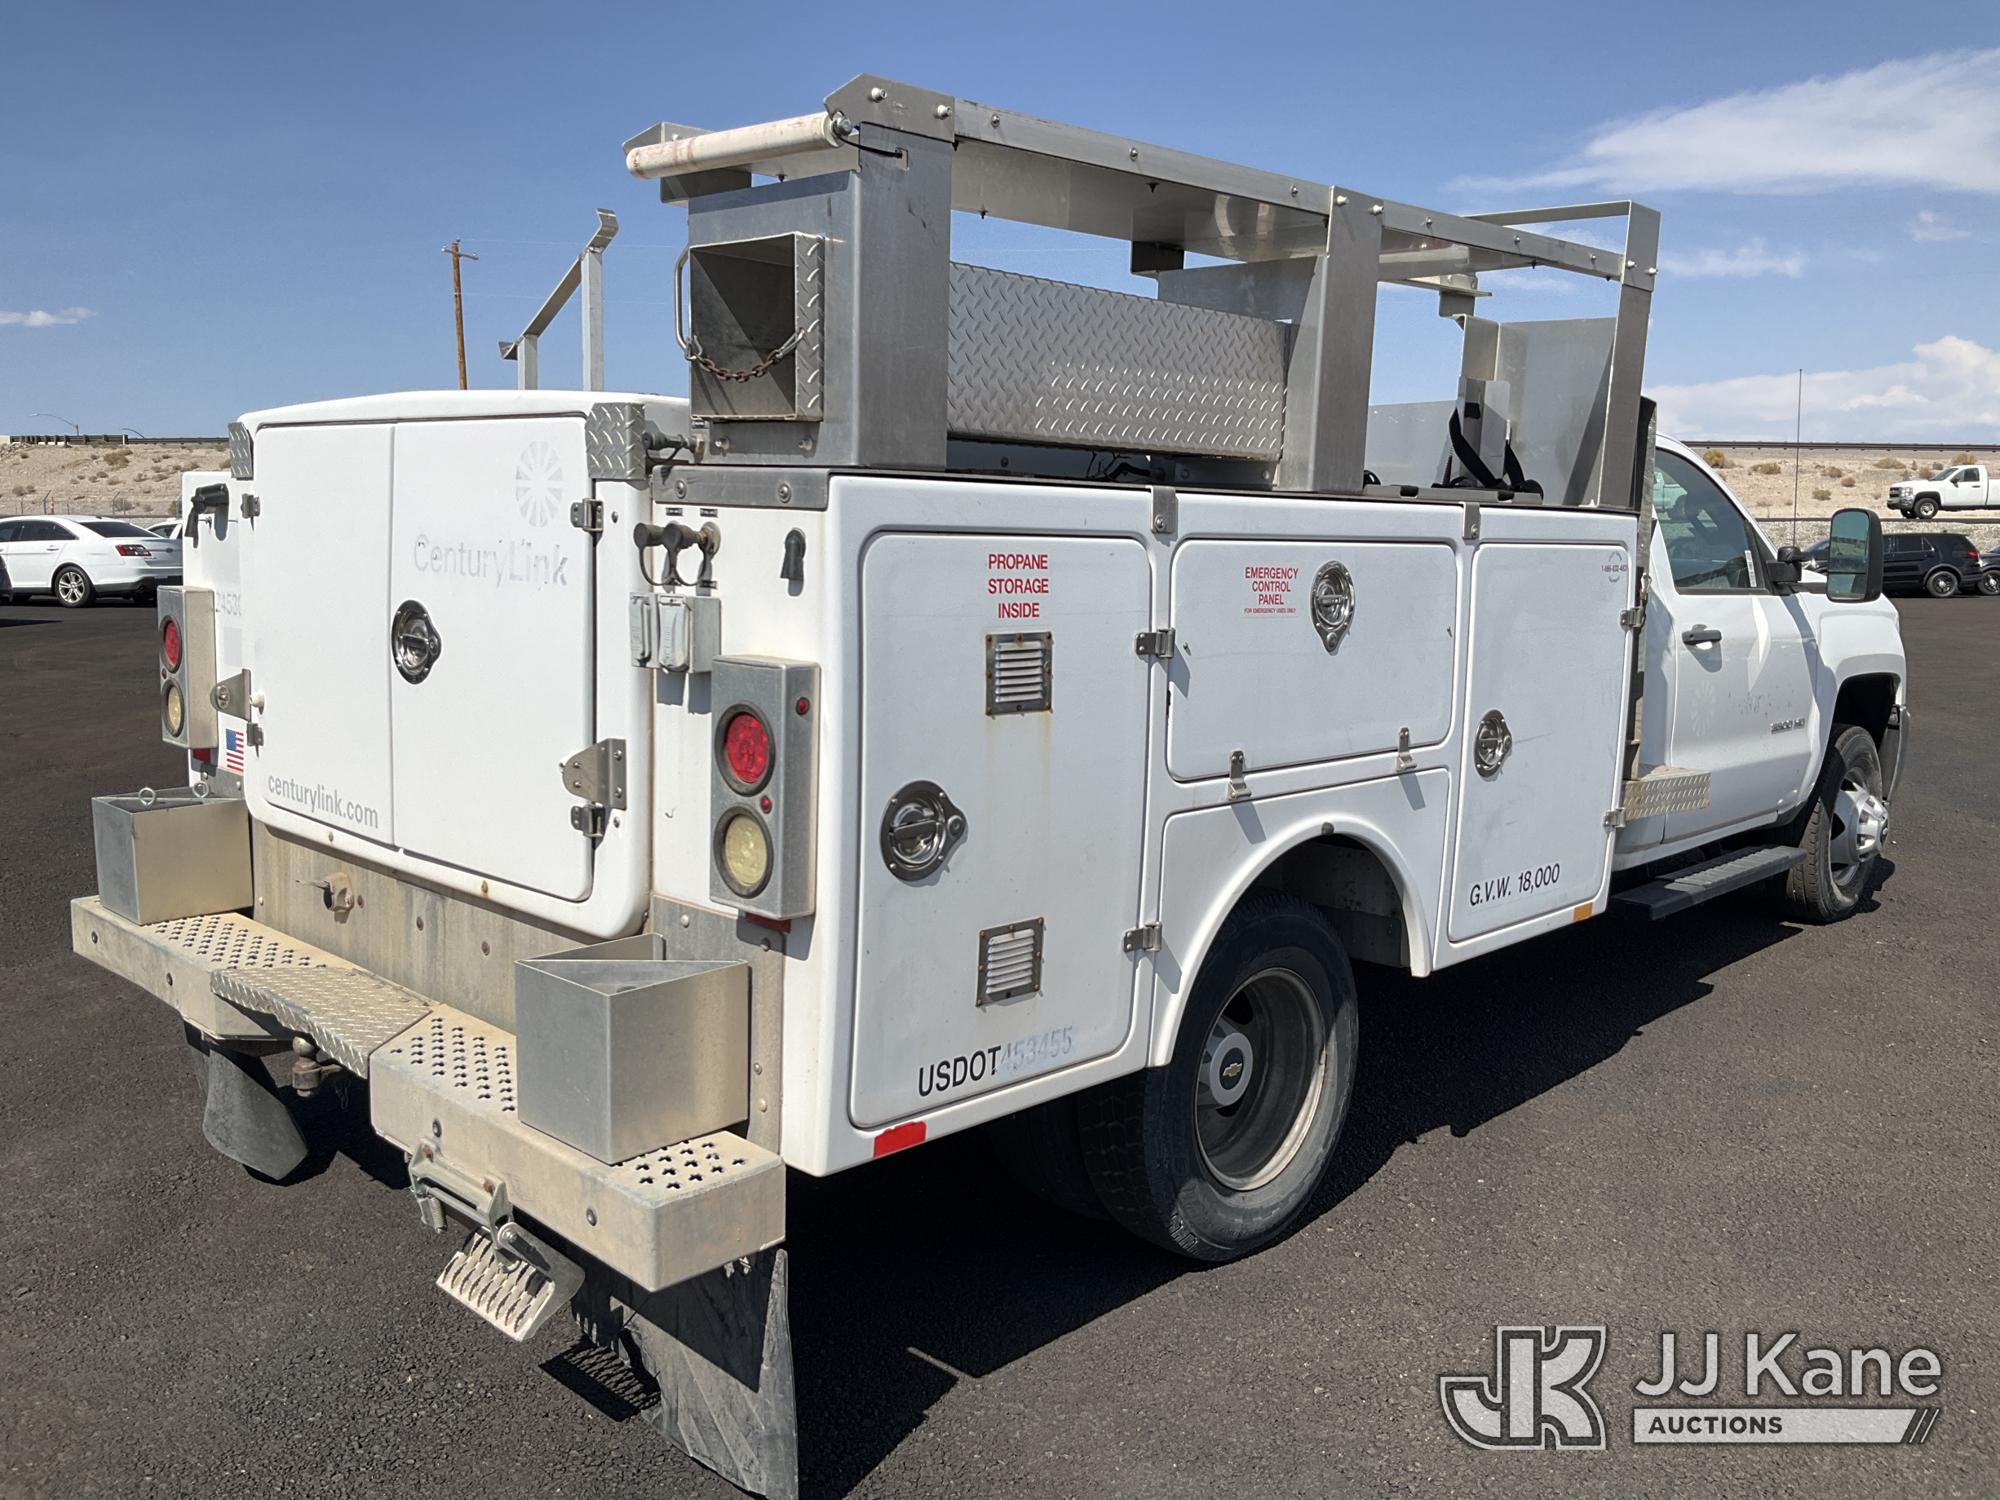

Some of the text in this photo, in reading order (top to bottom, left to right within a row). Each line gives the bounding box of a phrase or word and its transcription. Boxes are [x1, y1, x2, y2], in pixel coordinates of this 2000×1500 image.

[988, 554, 1048, 570] PROPANE
[1245, 567, 1299, 580] EMERGENCY
[988, 578, 1049, 594] STORAGE
[1252, 581, 1291, 592] CONTROL
[1259, 594, 1284, 605] PANEL
[998, 603, 1040, 618] INSIDE
[268, 776, 378, 829] centurylink.com
[1470, 863, 1560, 906] G.V.W. 18,000
